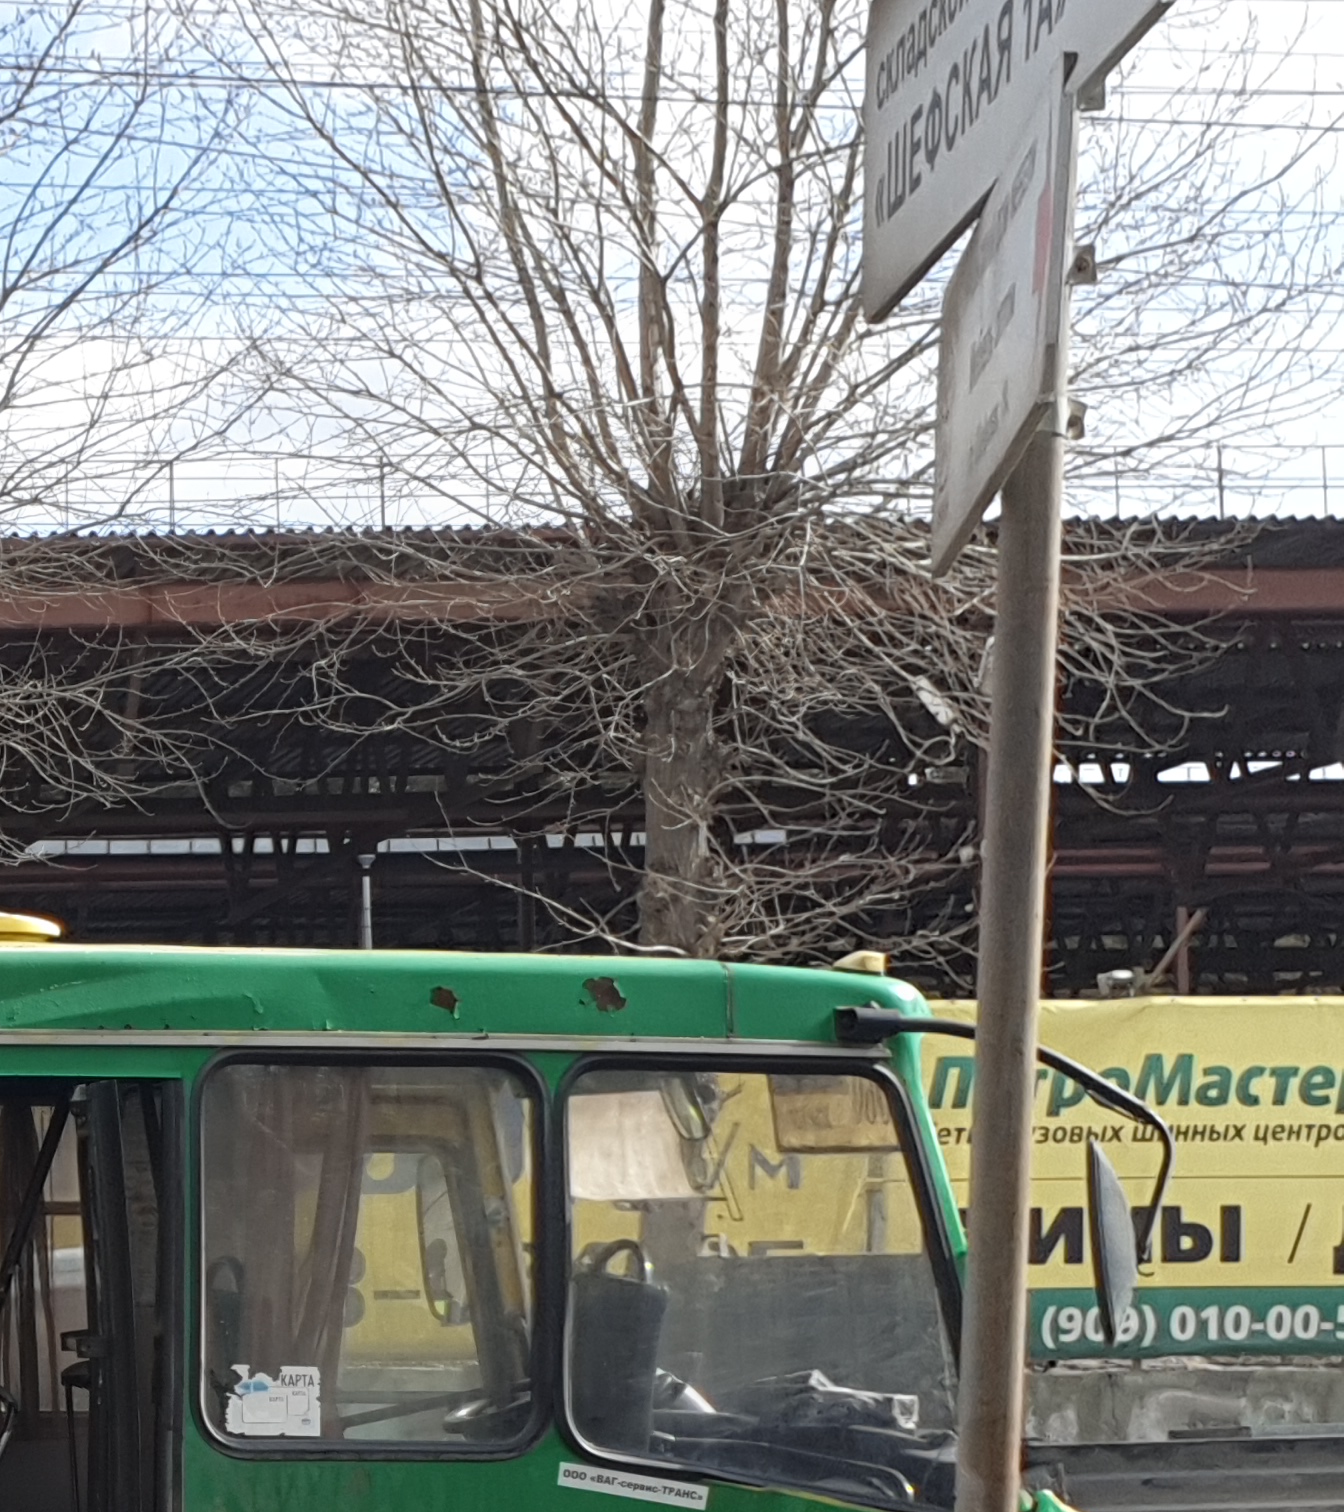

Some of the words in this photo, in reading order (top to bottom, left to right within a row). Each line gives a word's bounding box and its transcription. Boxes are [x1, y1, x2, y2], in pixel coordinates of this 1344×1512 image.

[280, 1373, 316, 1388] КАРТА
[562, 1468, 588, 1482] ООО
[589, 1474, 704, 1502] «ВАГ-сервис-ТРАНС»
